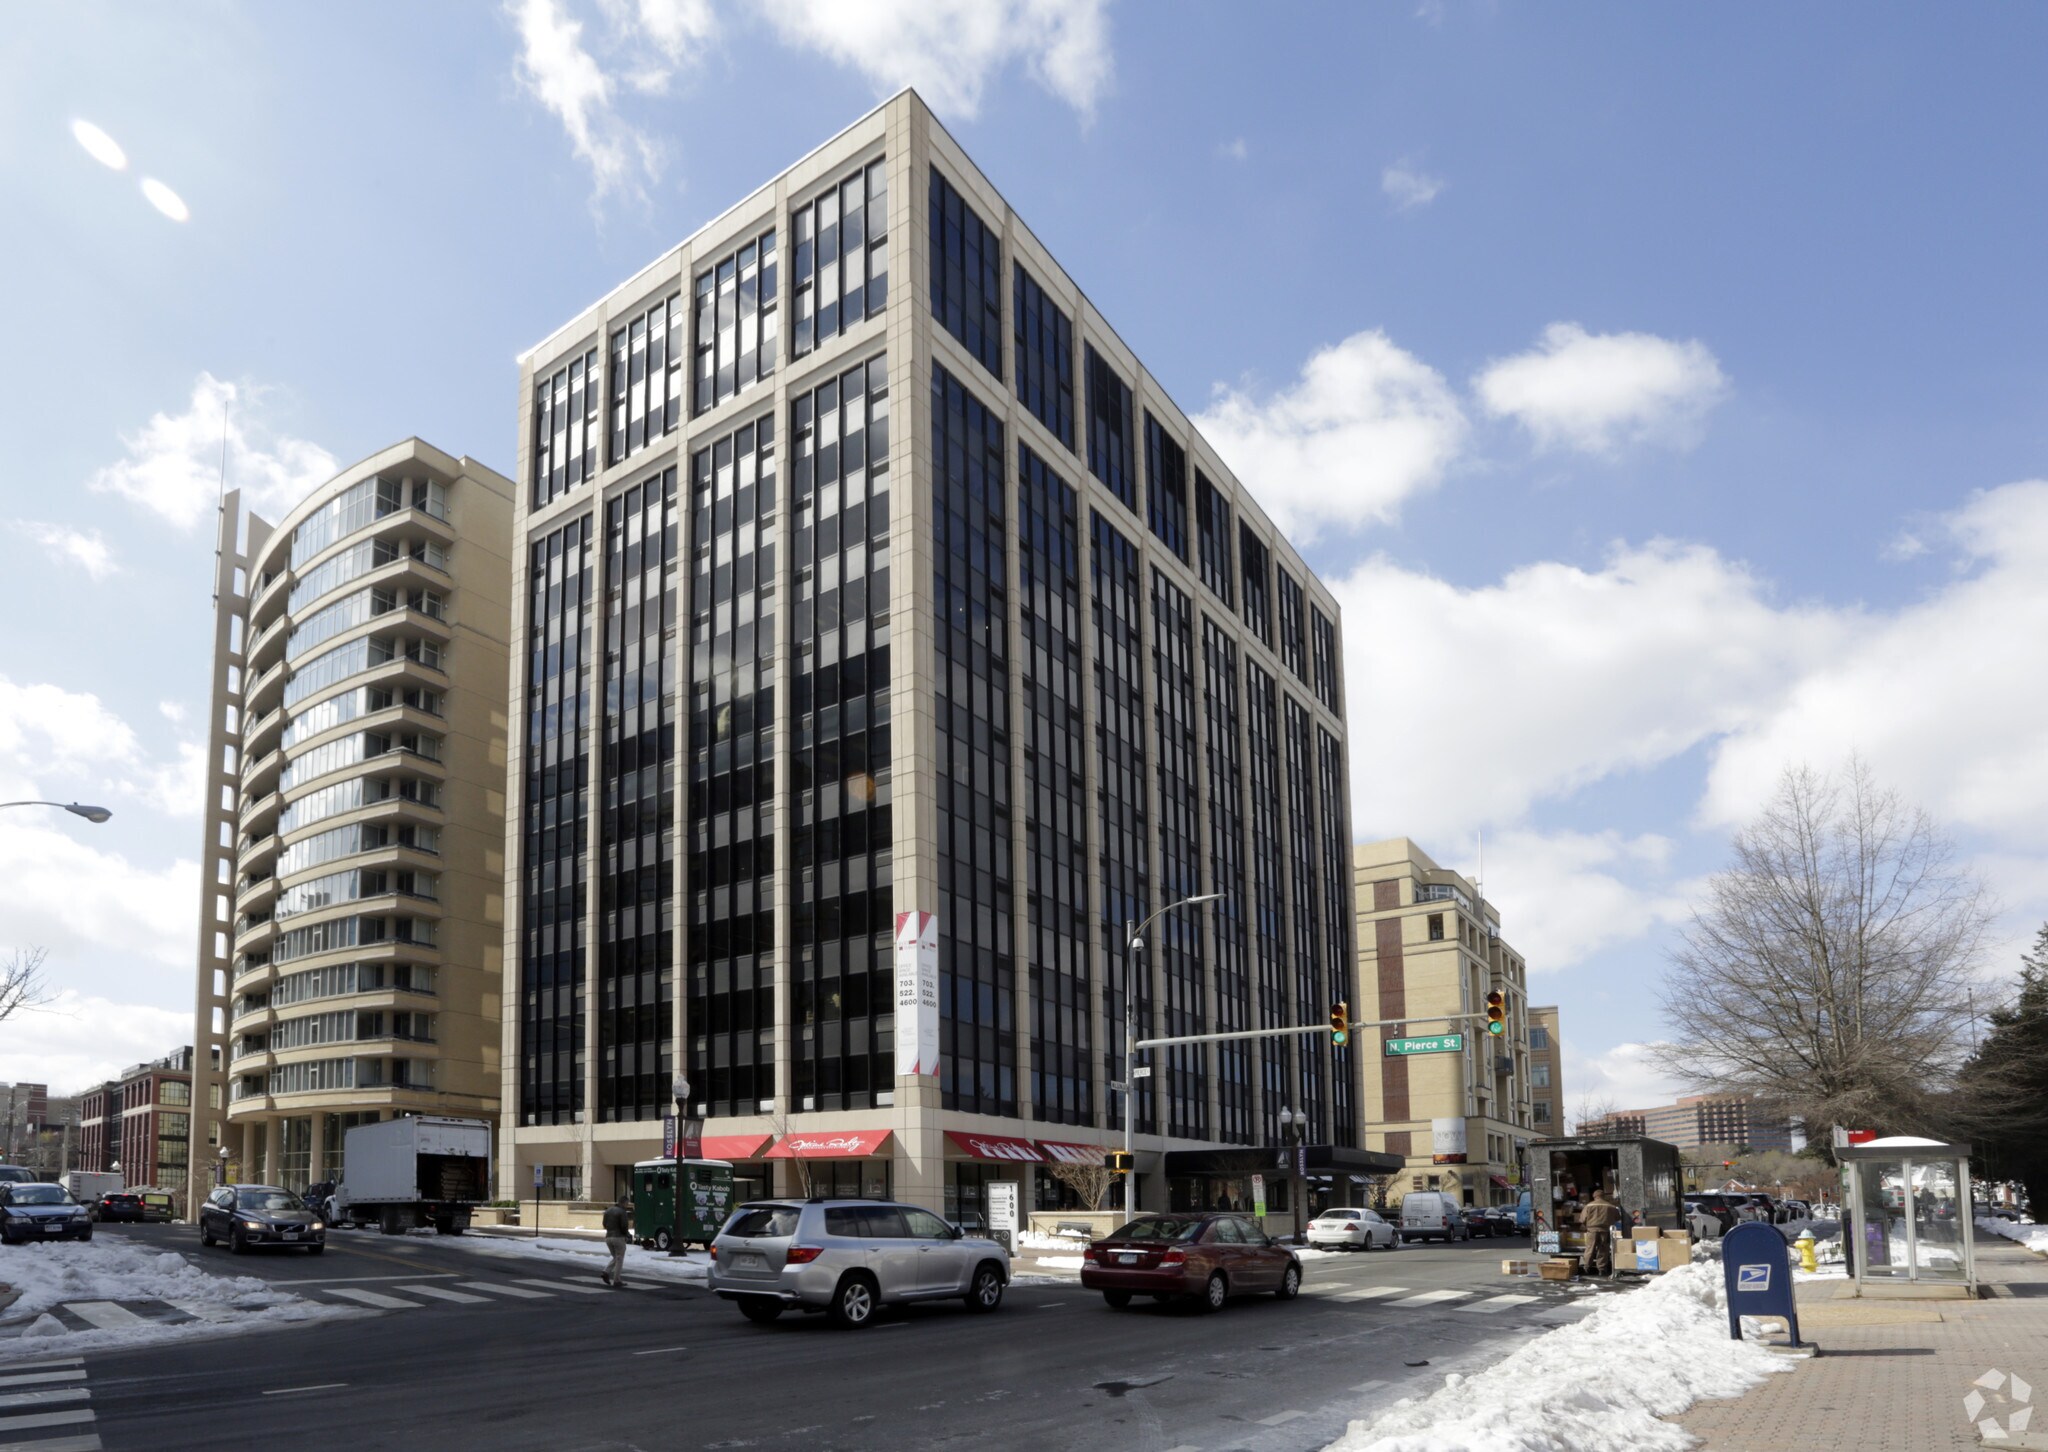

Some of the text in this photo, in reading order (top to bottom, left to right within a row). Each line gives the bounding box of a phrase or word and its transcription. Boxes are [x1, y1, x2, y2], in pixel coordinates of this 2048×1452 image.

[922, 999, 937, 1008] 4600
[1389, 1038, 1458, 1052] N. Pierce St.
[697, 1183, 730, 1192] Tasty Kabob
